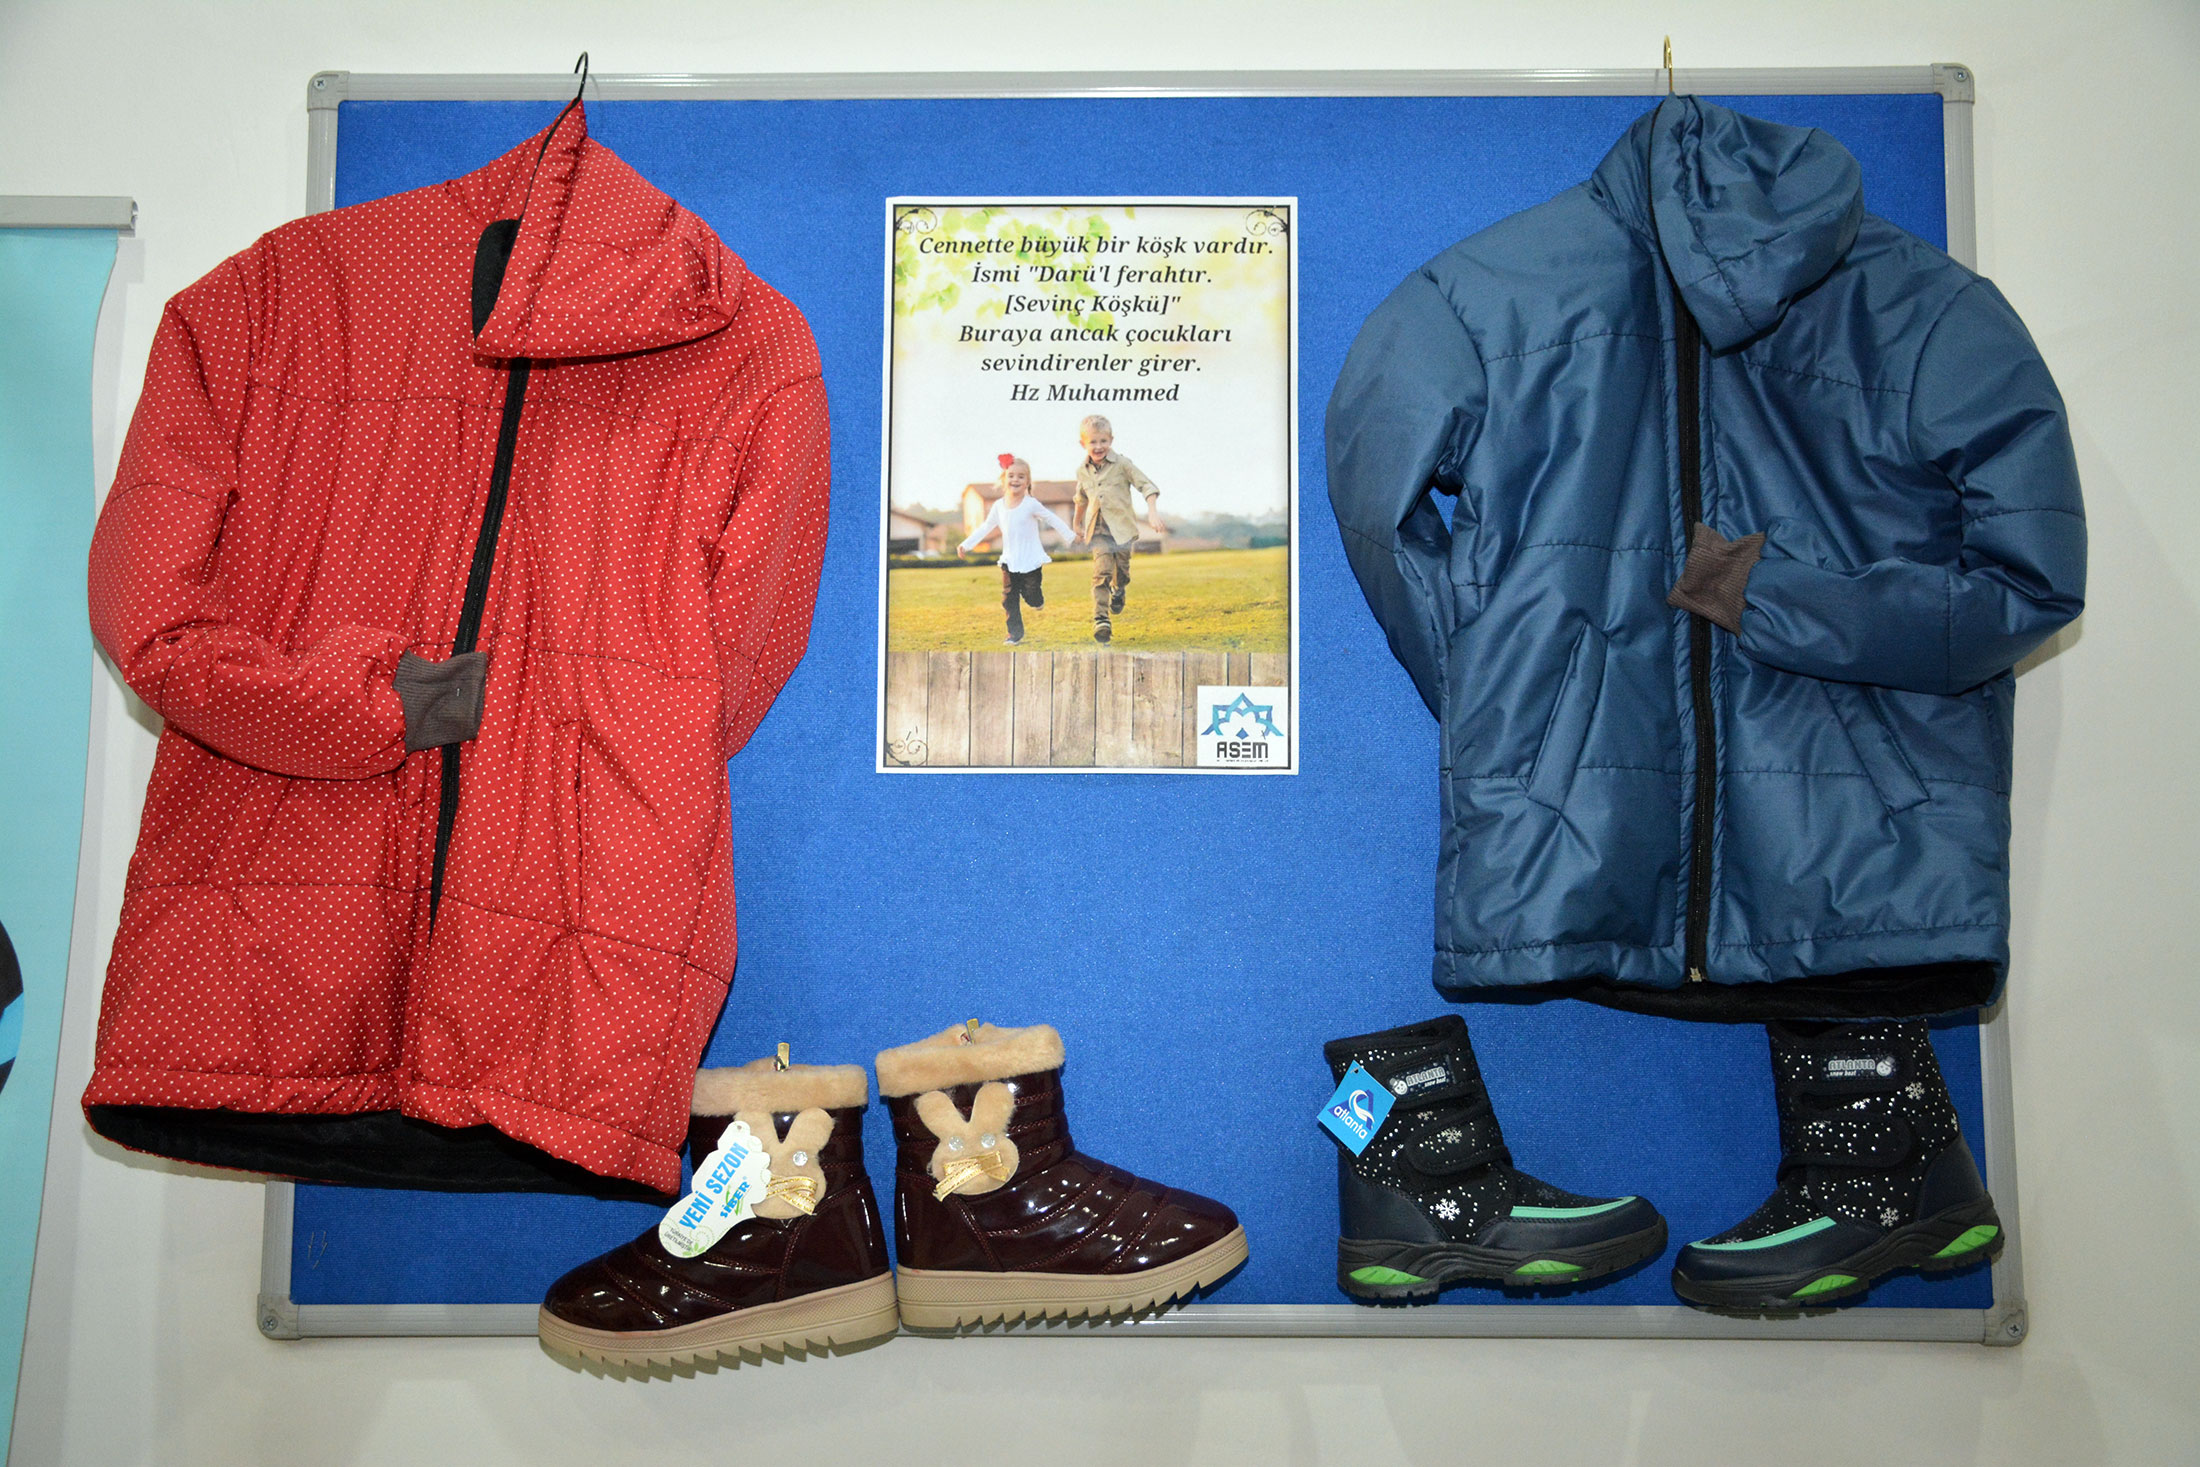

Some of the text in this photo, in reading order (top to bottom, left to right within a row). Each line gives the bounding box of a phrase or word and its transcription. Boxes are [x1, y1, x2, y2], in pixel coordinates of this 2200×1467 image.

[919, 235, 1273, 258] Cennette büyük bir köşk vardır.
[973, 262, 1211, 287] İsmi "Darü'l ferahtır.
[1005, 294, 1181, 317] [Sevinç Köşkü]"
[959, 324, 1231, 346] Buraya ancak çocukları
[981, 353, 1201, 376] sevindirenler girer.
[1011, 383, 1180, 401] Hz Muhammed
[1216, 741, 1268, 758] ASEM
[1405, 1066, 1446, 1086] ATLANTA
[1828, 1059, 1876, 1070] ATLANTA
[1333, 1105, 1368, 1140] atlanta
[706, 1142, 749, 1194] SEZON
